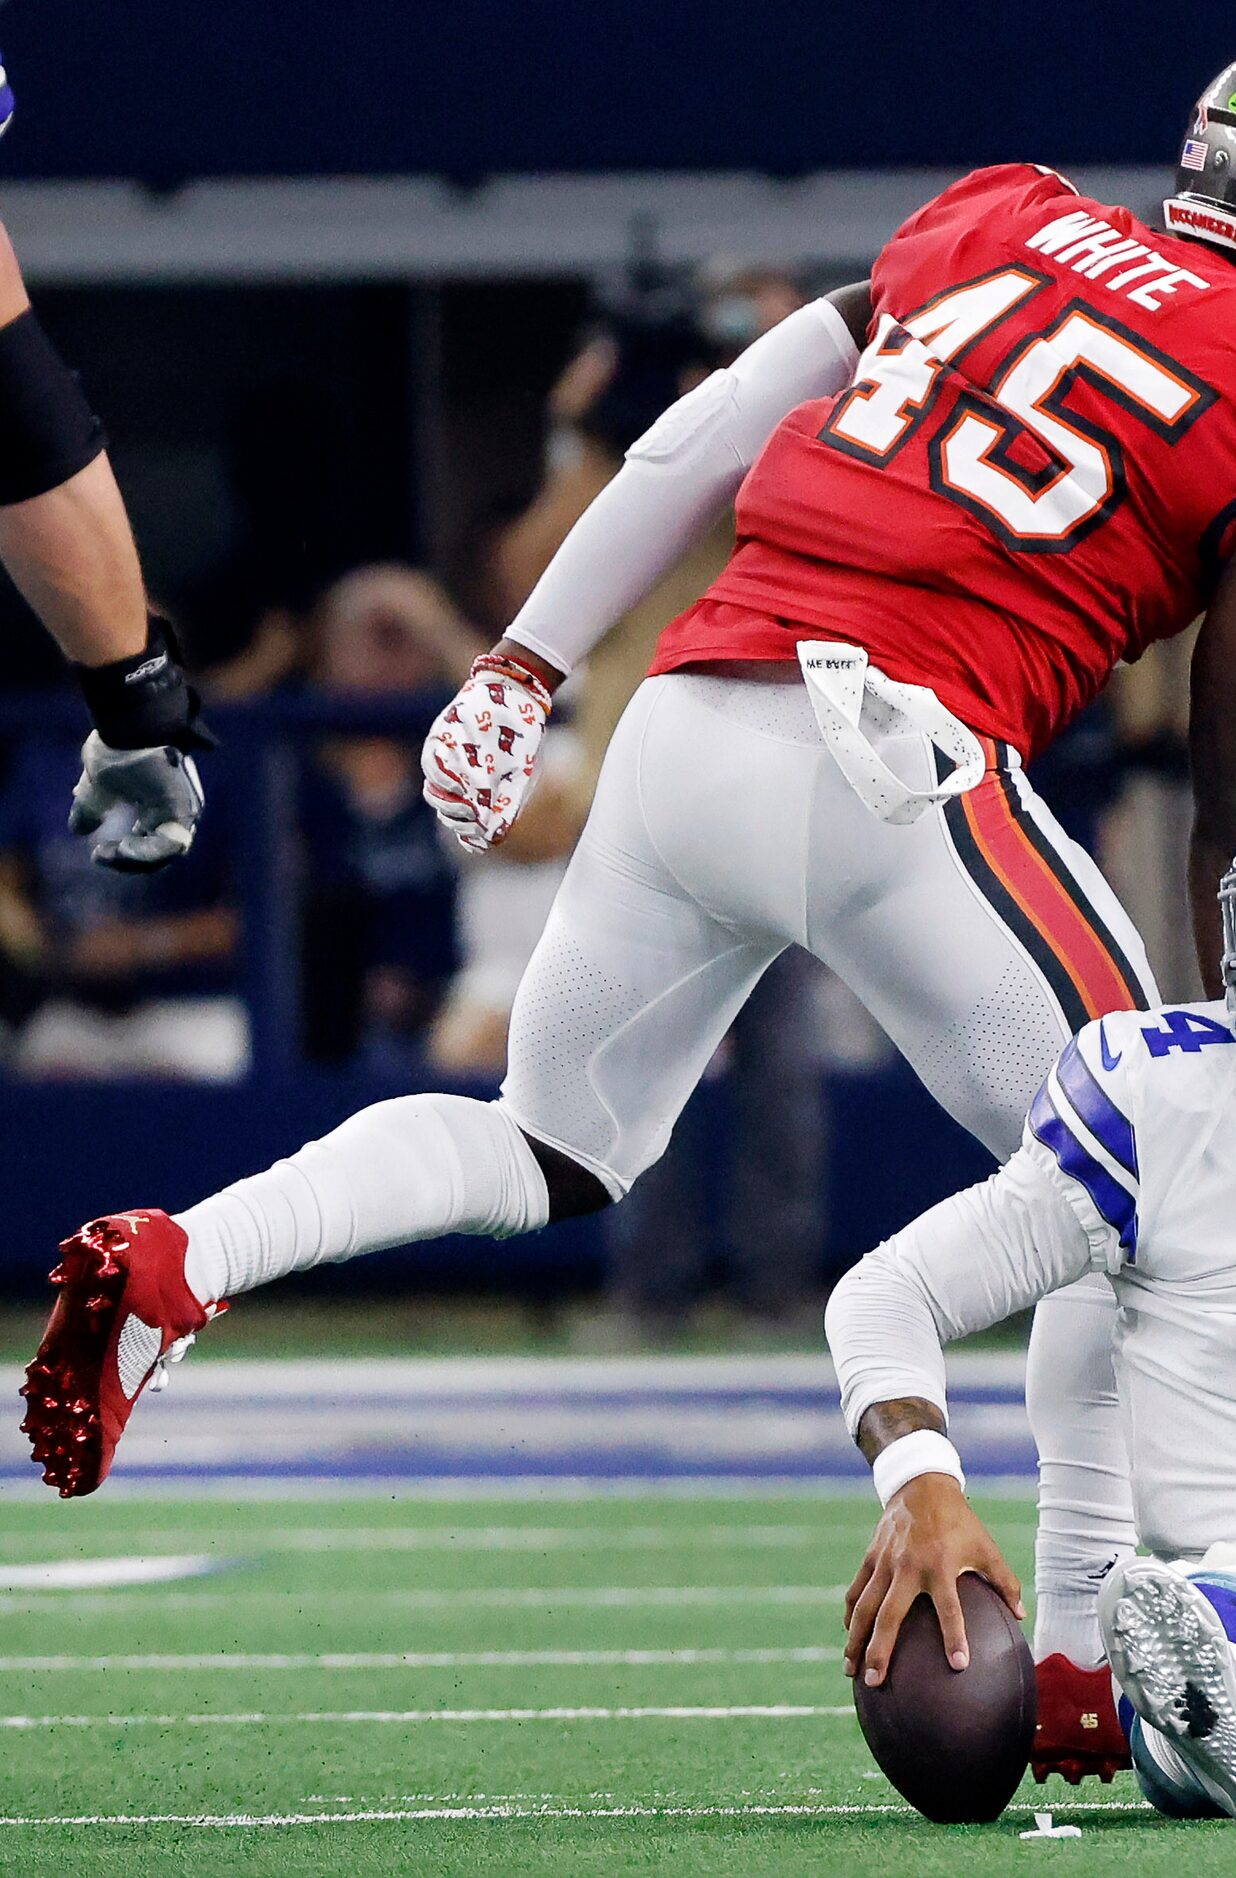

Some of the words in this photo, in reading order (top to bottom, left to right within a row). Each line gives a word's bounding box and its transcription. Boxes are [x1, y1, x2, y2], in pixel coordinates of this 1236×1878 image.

[1024, 210, 1211, 312] WHITE
[817, 261, 1221, 553] 45
[1080, 1712, 1099, 1729] 45
